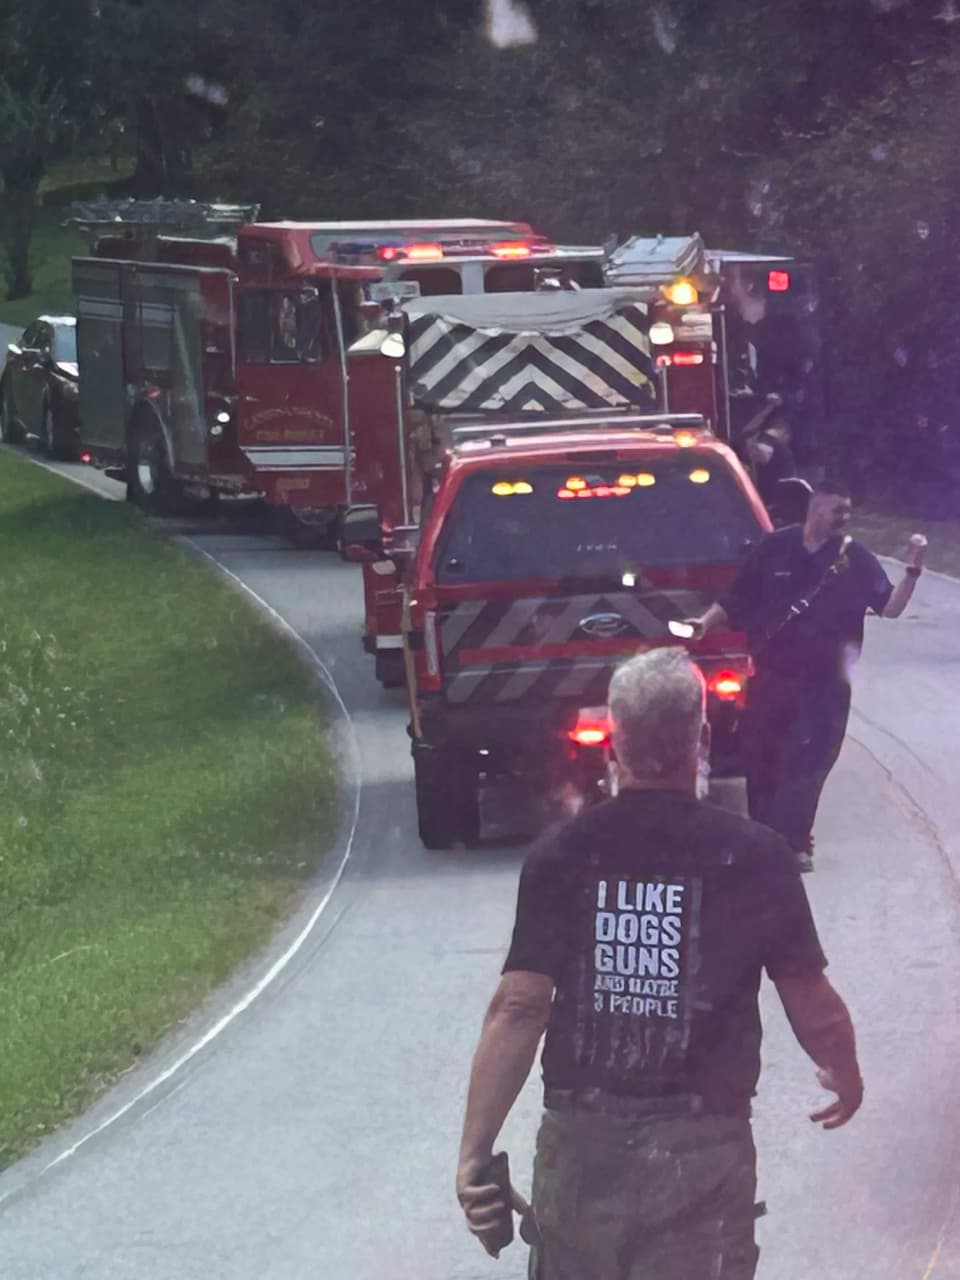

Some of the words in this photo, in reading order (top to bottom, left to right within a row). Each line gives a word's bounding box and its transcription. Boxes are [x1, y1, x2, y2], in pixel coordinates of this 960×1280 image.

[597, 880, 607, 908] I
[617, 880, 685, 913] LIKE
[595, 911, 682, 946] DOGS
[594, 943, 680, 977] GUNS
[594, 974, 625, 992] AND
[628, 977, 679, 997] MAYBE
[609, 994, 678, 1019] PEOPLE
